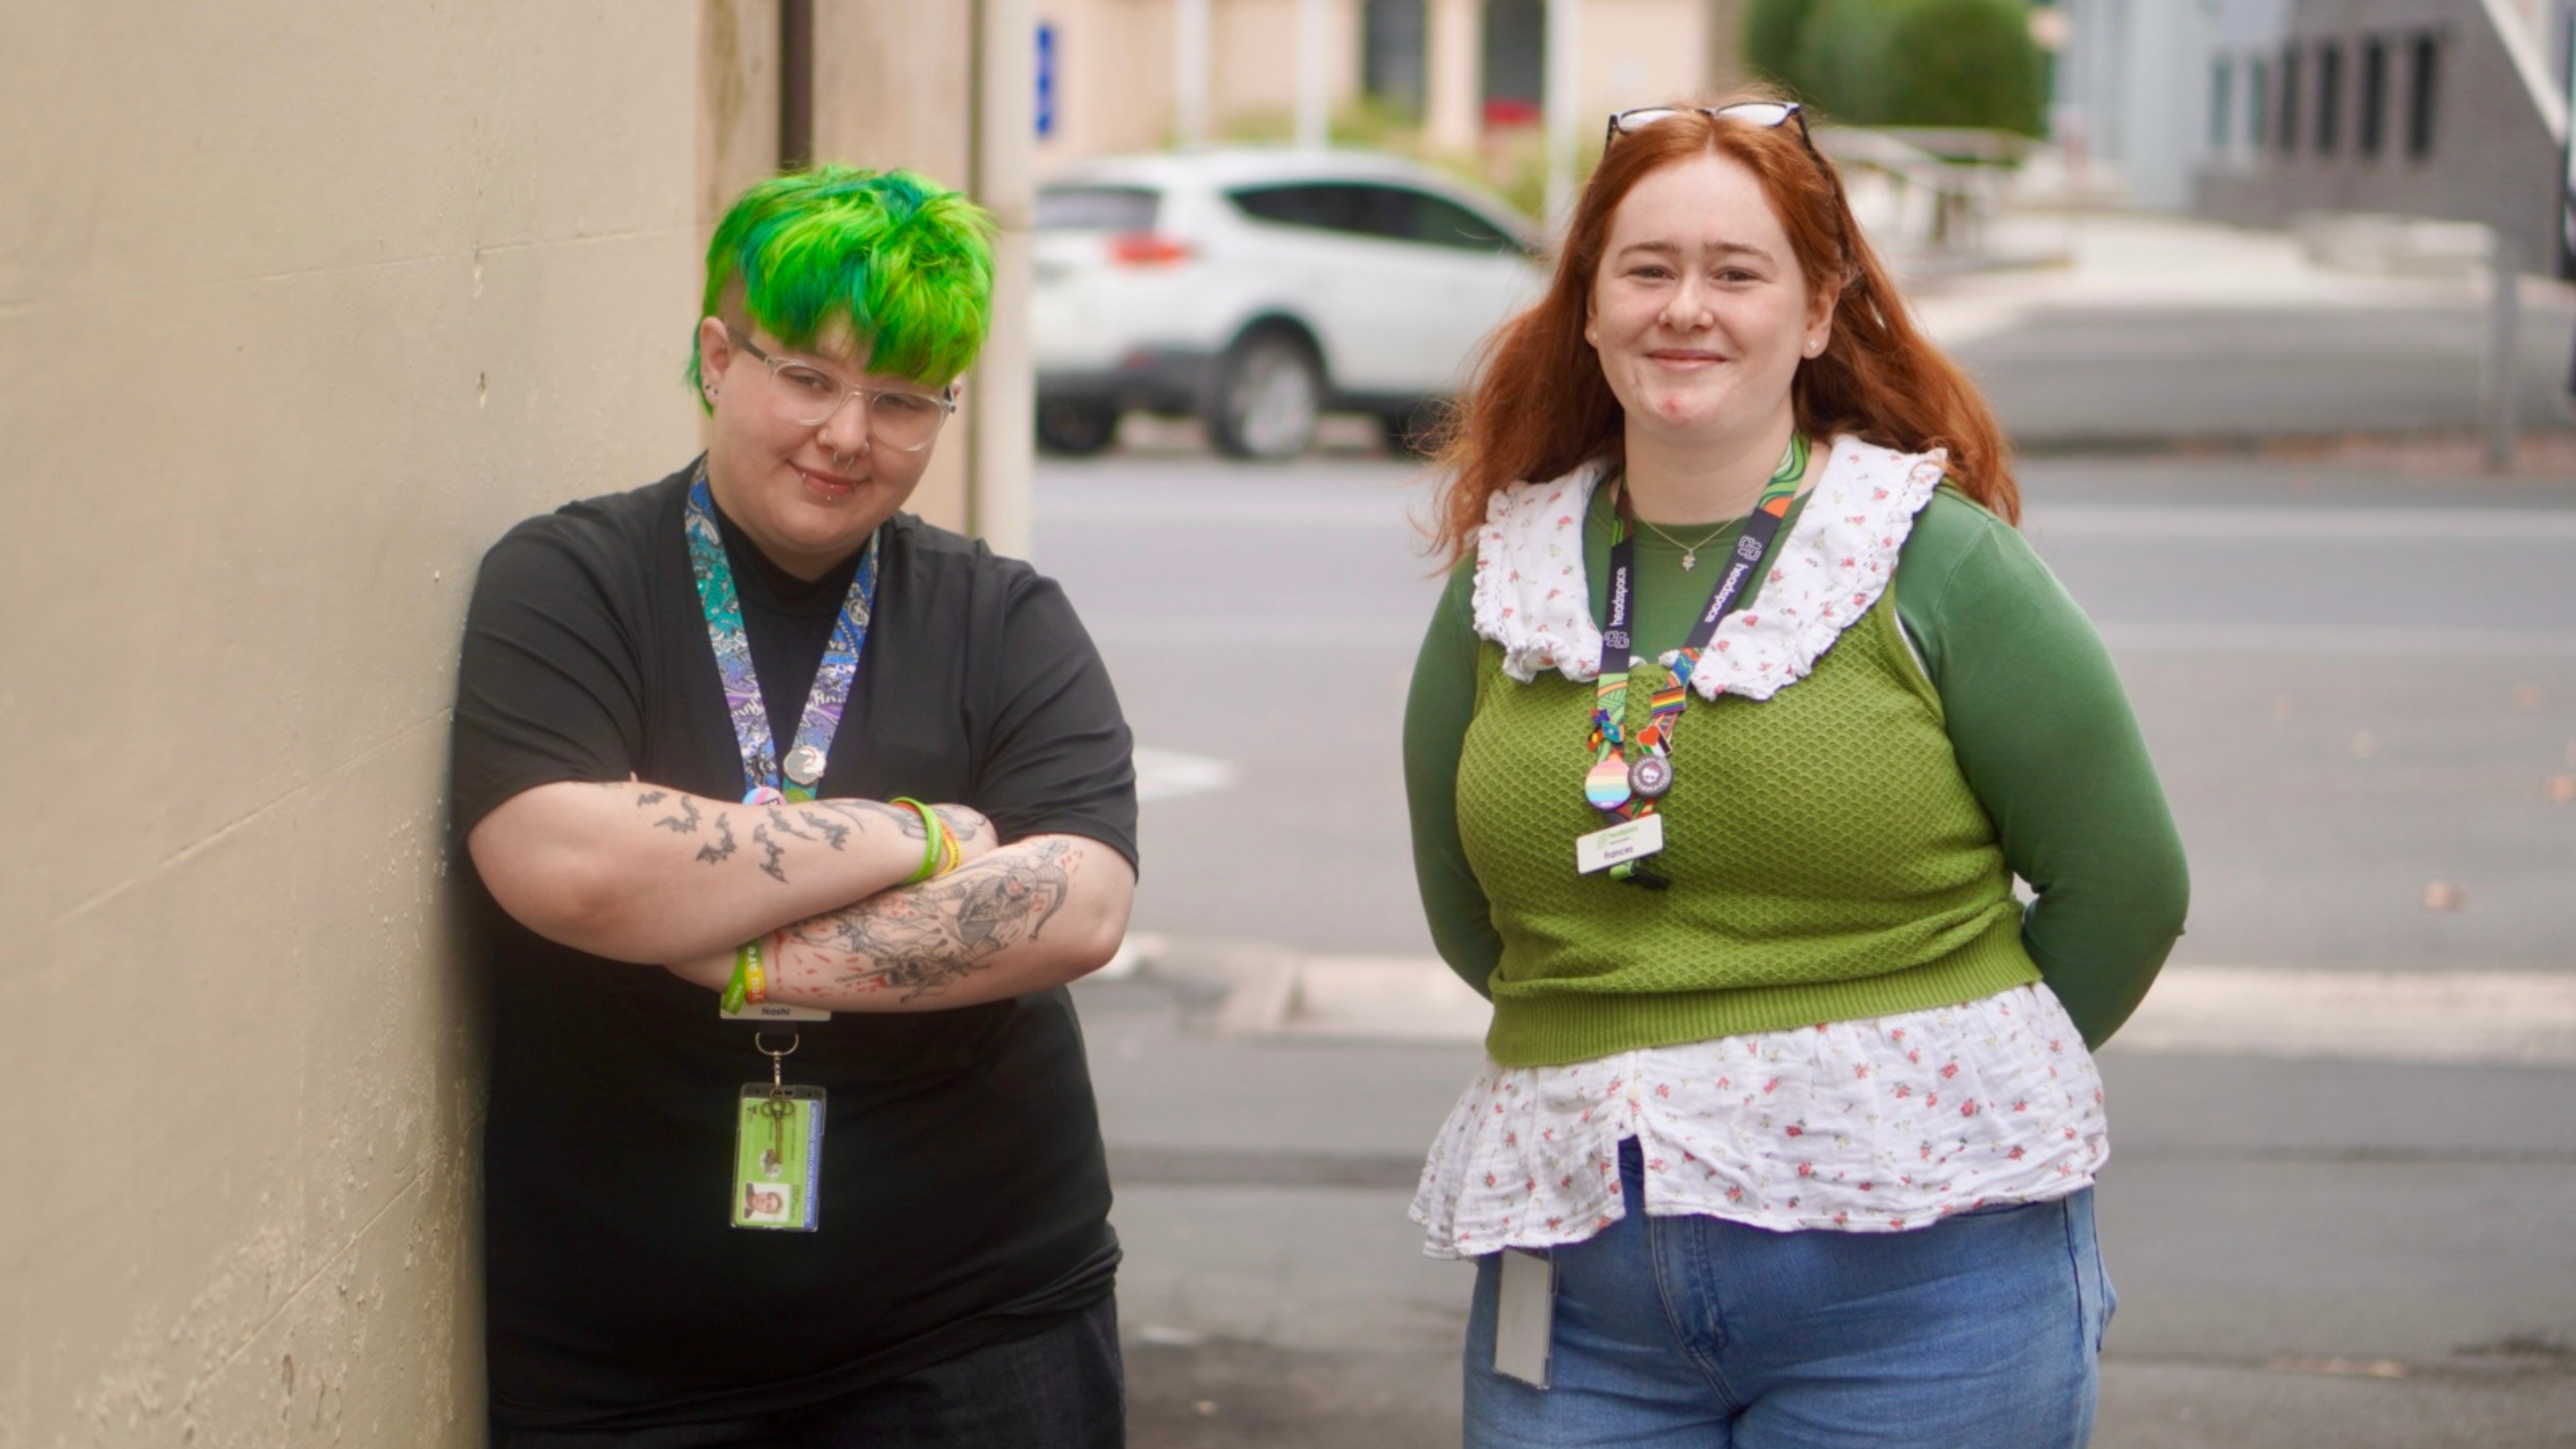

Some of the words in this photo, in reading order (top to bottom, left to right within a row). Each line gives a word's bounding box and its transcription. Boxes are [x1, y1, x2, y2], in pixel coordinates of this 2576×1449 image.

[1609, 566, 1627, 626] headspace
[1704, 563, 1750, 623] headspace
[746, 945, 758, 972] are
[751, 977, 765, 1001] you
